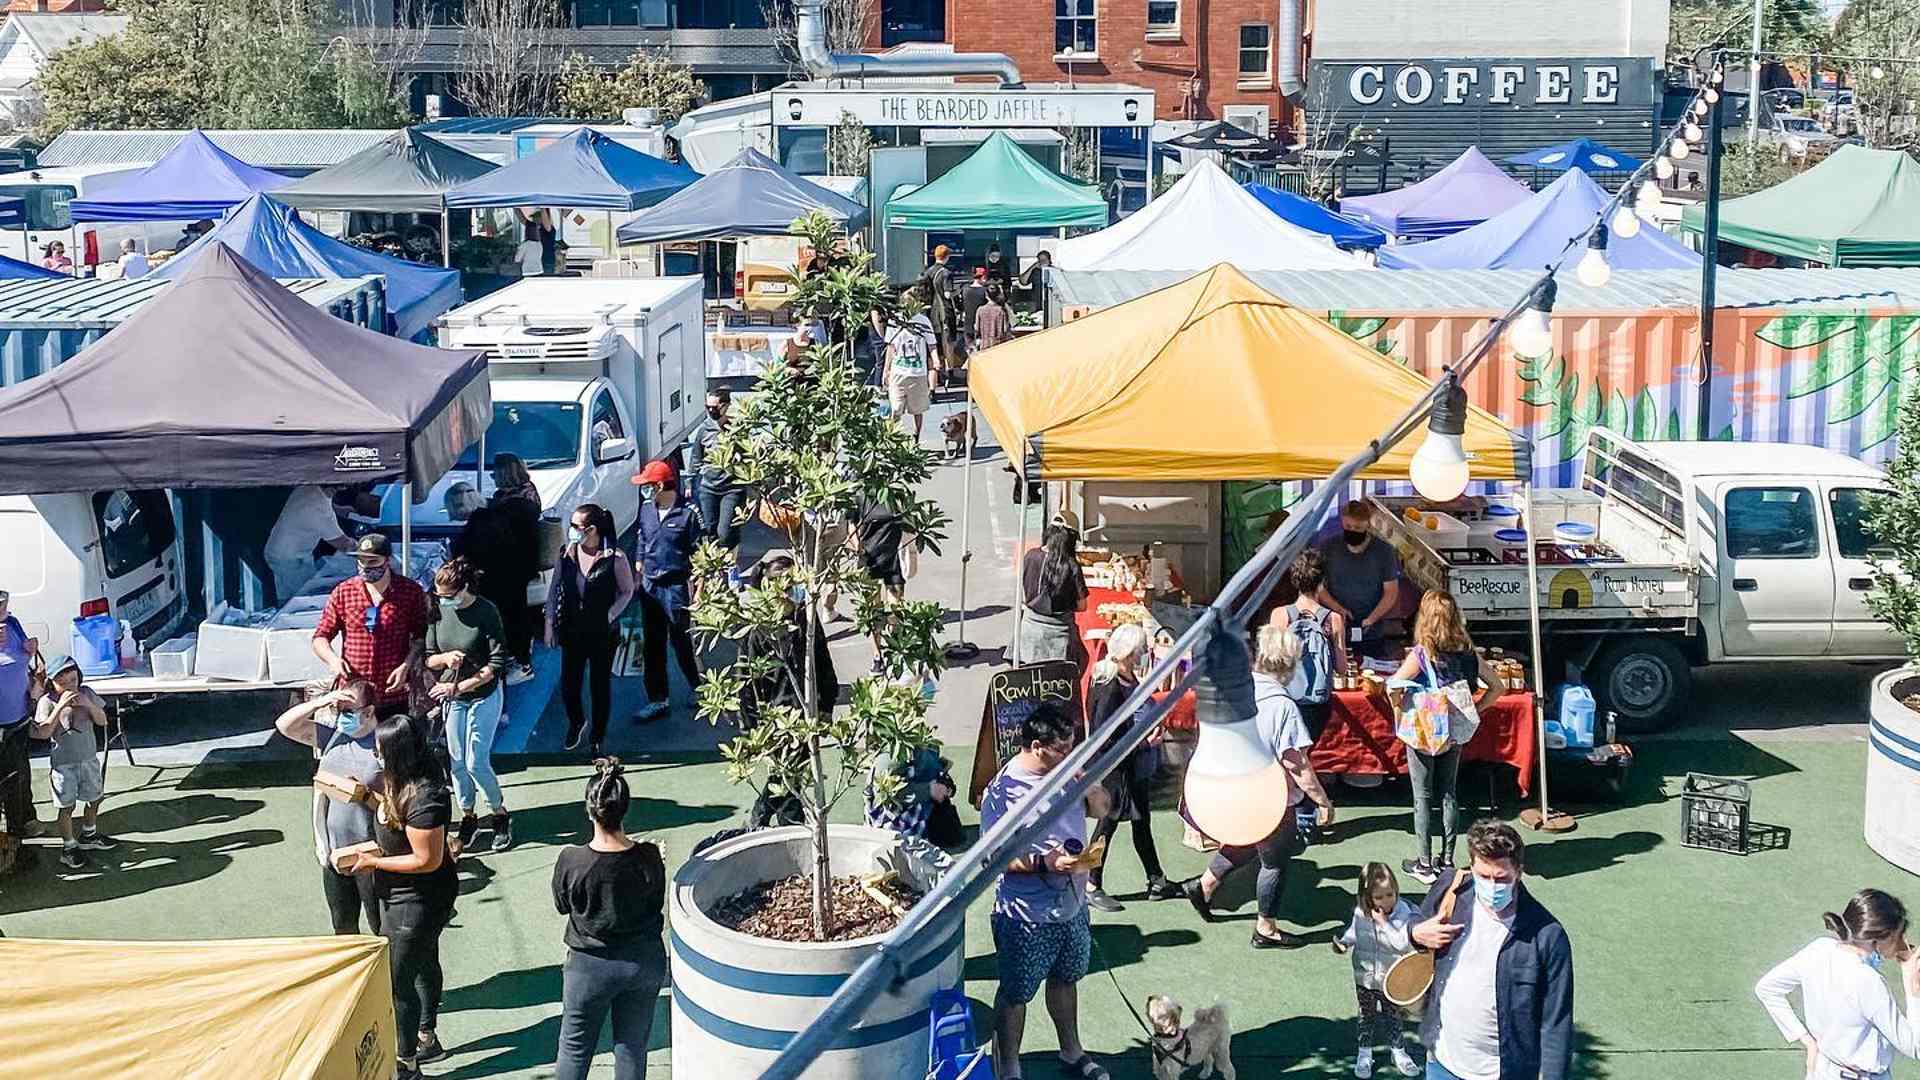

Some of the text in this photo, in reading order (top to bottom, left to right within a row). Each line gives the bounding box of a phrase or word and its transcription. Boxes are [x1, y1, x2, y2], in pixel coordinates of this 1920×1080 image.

[1350, 64, 1619, 105] COFFEE
[881, 98, 1048, 121] THE BEARDED JAFFLE
[1459, 577, 1521, 594] BeeRescue
[1603, 576, 1664, 595] Raw Honey
[992, 668, 1073, 704] Raw Honey
